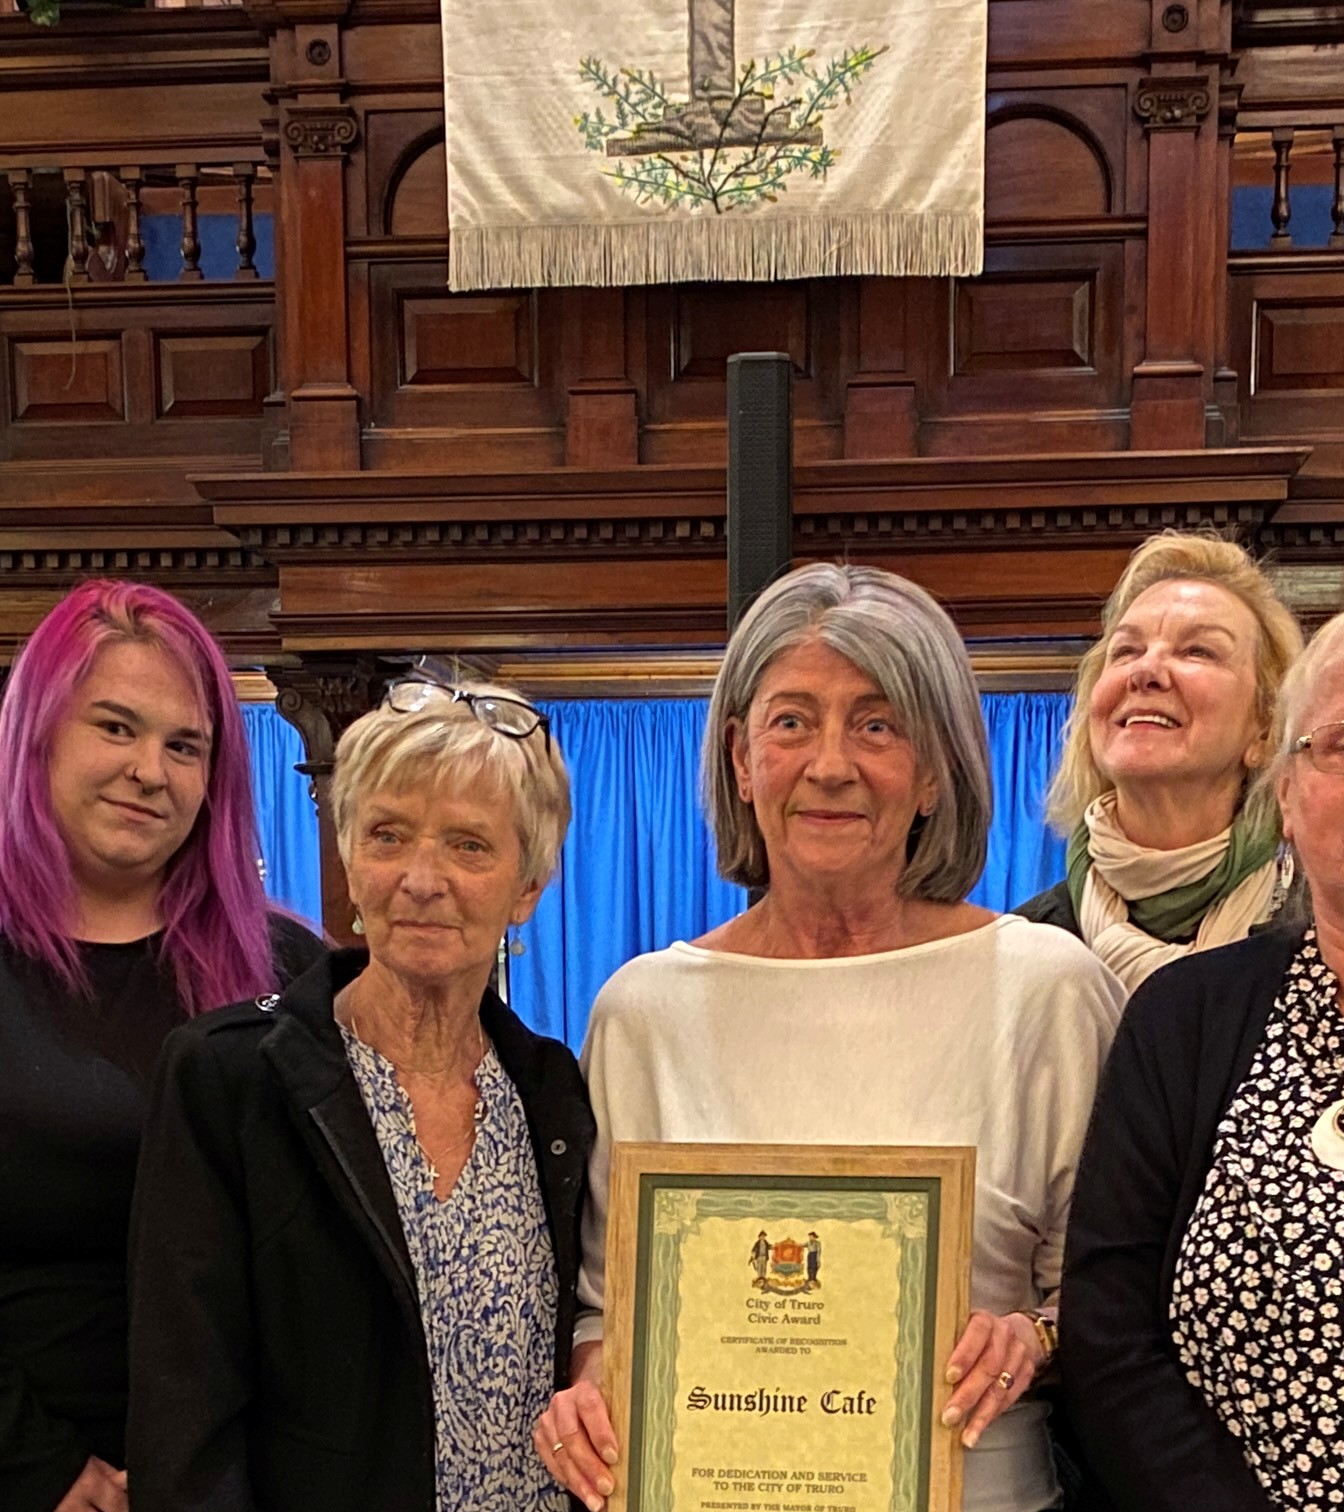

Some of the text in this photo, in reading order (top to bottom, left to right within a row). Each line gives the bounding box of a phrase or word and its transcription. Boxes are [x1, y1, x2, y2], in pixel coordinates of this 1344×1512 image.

[746, 1298, 825, 1311] City of Truro
[748, 1313, 821, 1325] Civic Award
[720, 1336, 774, 1345] CERTIFICATE
[789, 1337, 847, 1346] RECOGNITION
[756, 1346, 811, 1355] AWARDED TO
[686, 1386, 877, 1417] Sunshine Cafe
[692, 1468, 867, 1483] FOR DEDICATION AND SERVICE
[713, 1481, 844, 1494] TO THE CITY OF TRURO
[701, 1502, 748, 1510] PRESENTED
[764, 1503, 780, 1511] THE
[783, 1504, 811, 1512] MAYOR
[814, 1505, 825, 1512] OF
[827, 1505, 856, 1512] TRURO
